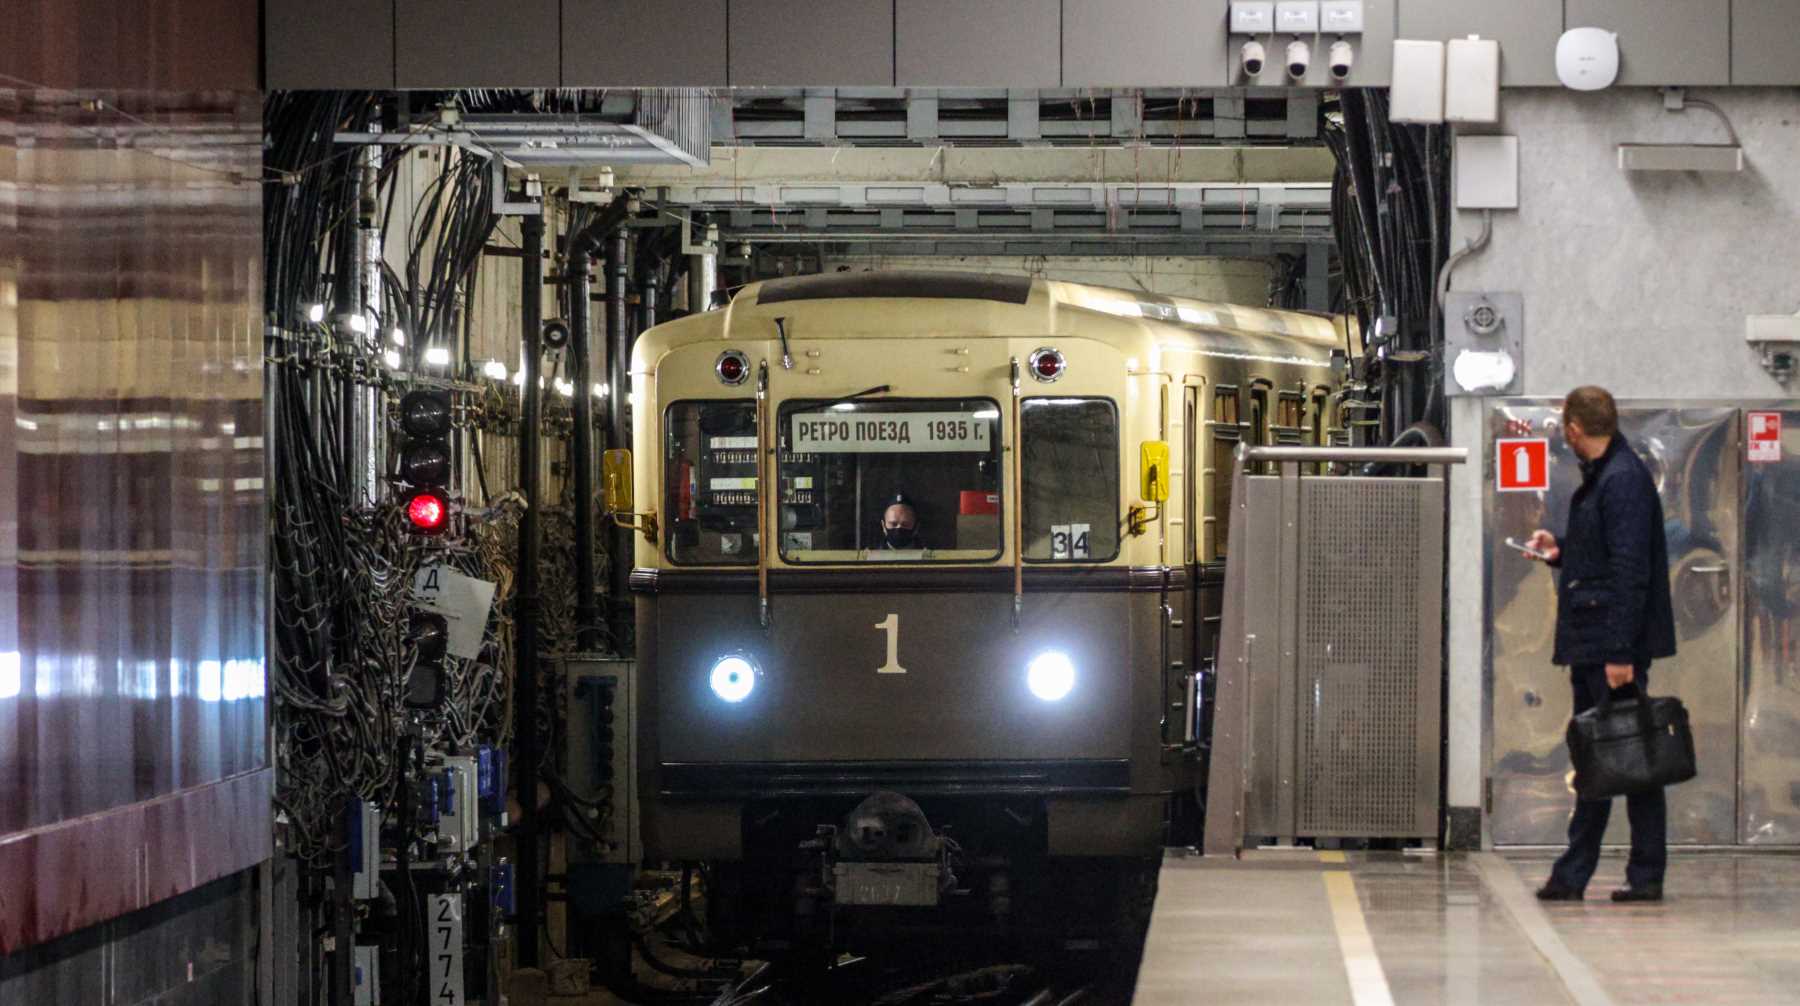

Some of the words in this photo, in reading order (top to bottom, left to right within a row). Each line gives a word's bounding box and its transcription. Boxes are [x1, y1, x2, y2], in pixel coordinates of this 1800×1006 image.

[799, 421, 849, 441] РЕТРО
[856, 421, 910, 443] ПОЕЗД
[927, 421, 967, 440] 1935
[1053, 532, 1089, 554] 34
[423, 569, 439, 591] Д
[875, 613, 907, 673] 1
